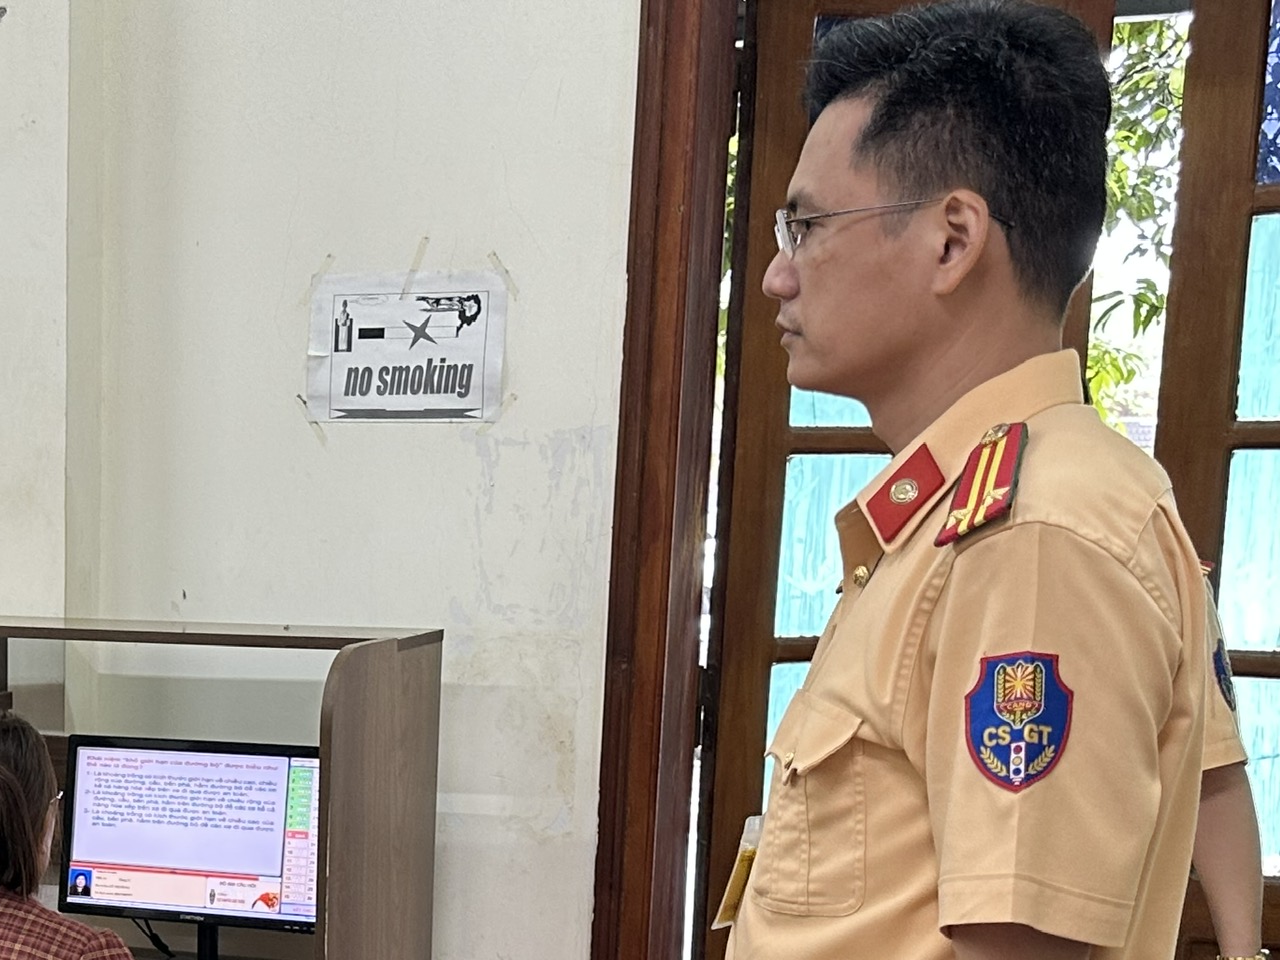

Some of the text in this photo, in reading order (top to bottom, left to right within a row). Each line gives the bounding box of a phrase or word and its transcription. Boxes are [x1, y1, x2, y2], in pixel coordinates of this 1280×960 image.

[343, 357, 474, 399] no smoking
[983, 723, 1052, 747] CS GT
